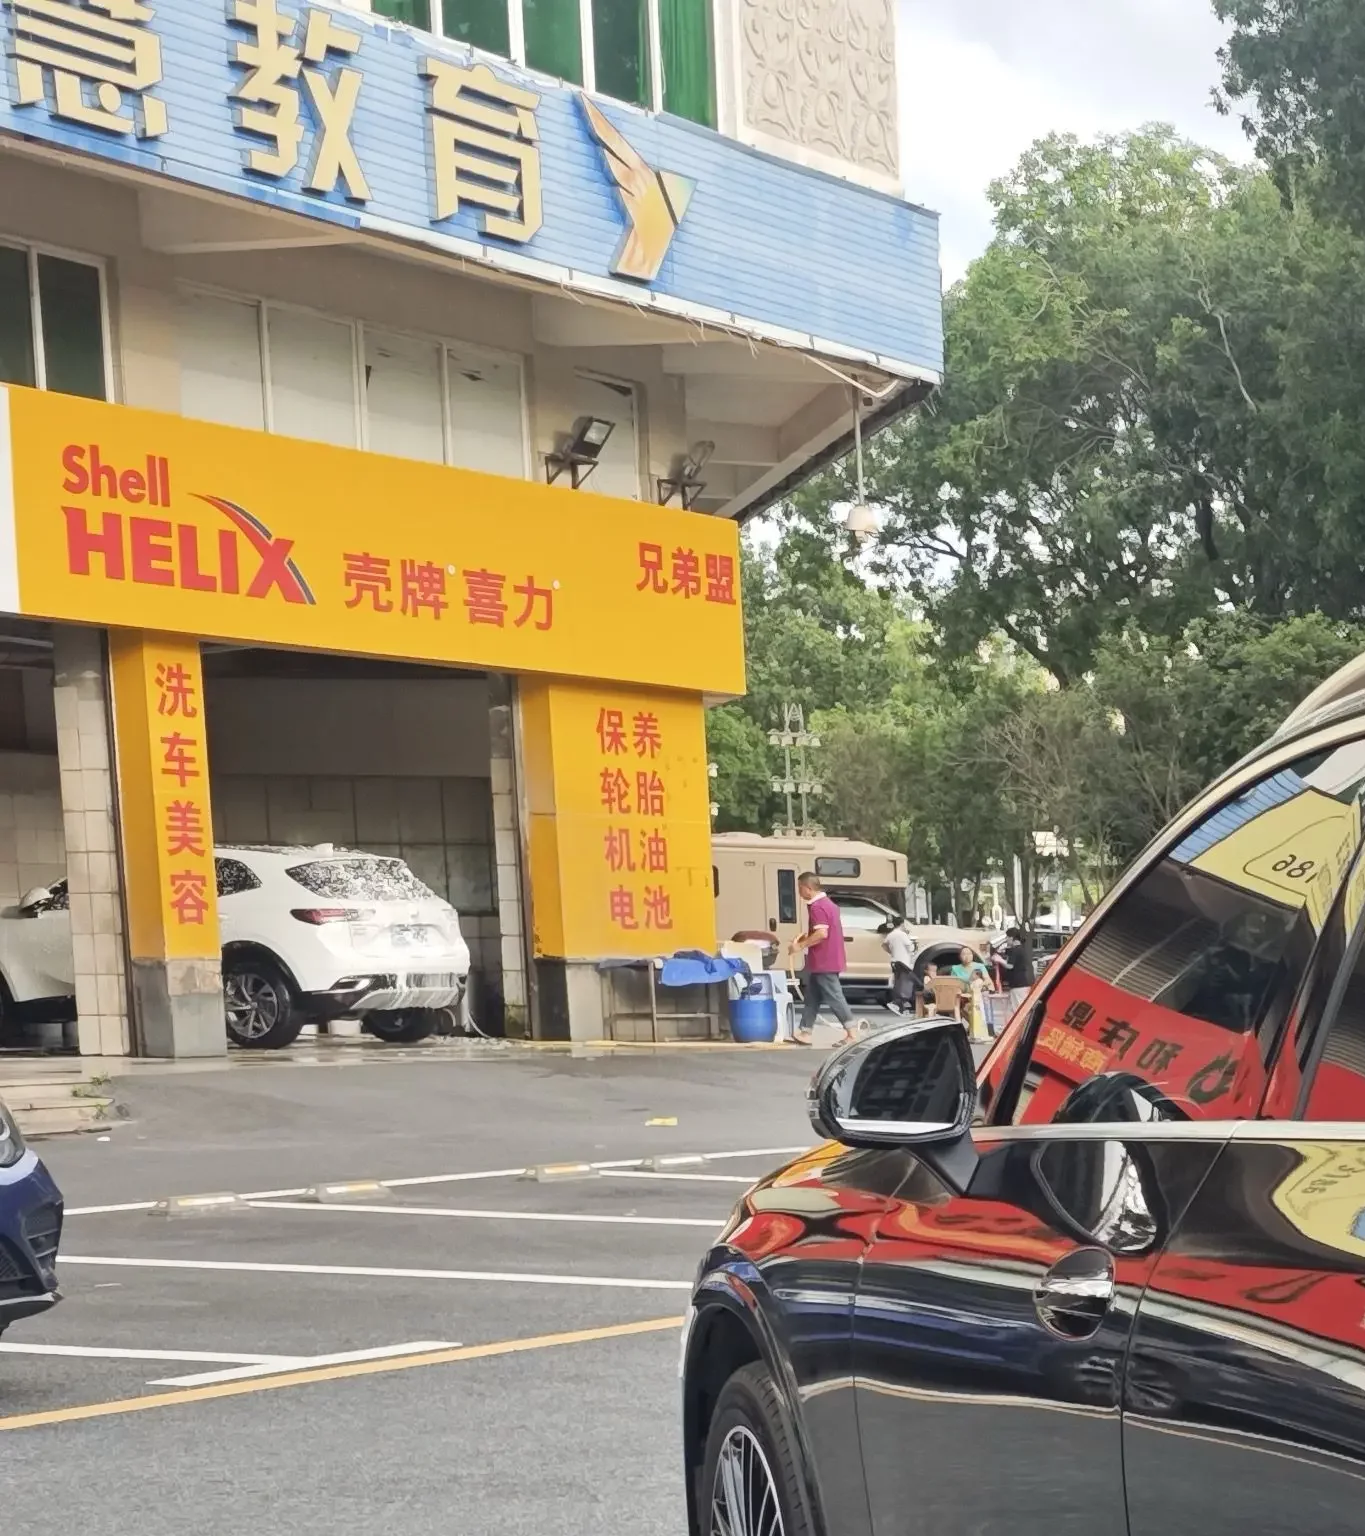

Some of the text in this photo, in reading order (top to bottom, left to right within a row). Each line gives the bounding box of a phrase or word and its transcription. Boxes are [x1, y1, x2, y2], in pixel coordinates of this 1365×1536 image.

[61, 443, 170, 508] Shell
[61, 503, 304, 605] HELIX
[636, 541, 737, 606] 兄弟盟
[342, 551, 556, 631] 壳牌喜力
[596, 707, 662, 759] 保养
[155, 662, 209, 926] 洗车美容
[600, 767, 665, 816] 轮胎
[604, 825, 669, 874] 机油
[609, 884, 673, 930] 电池
